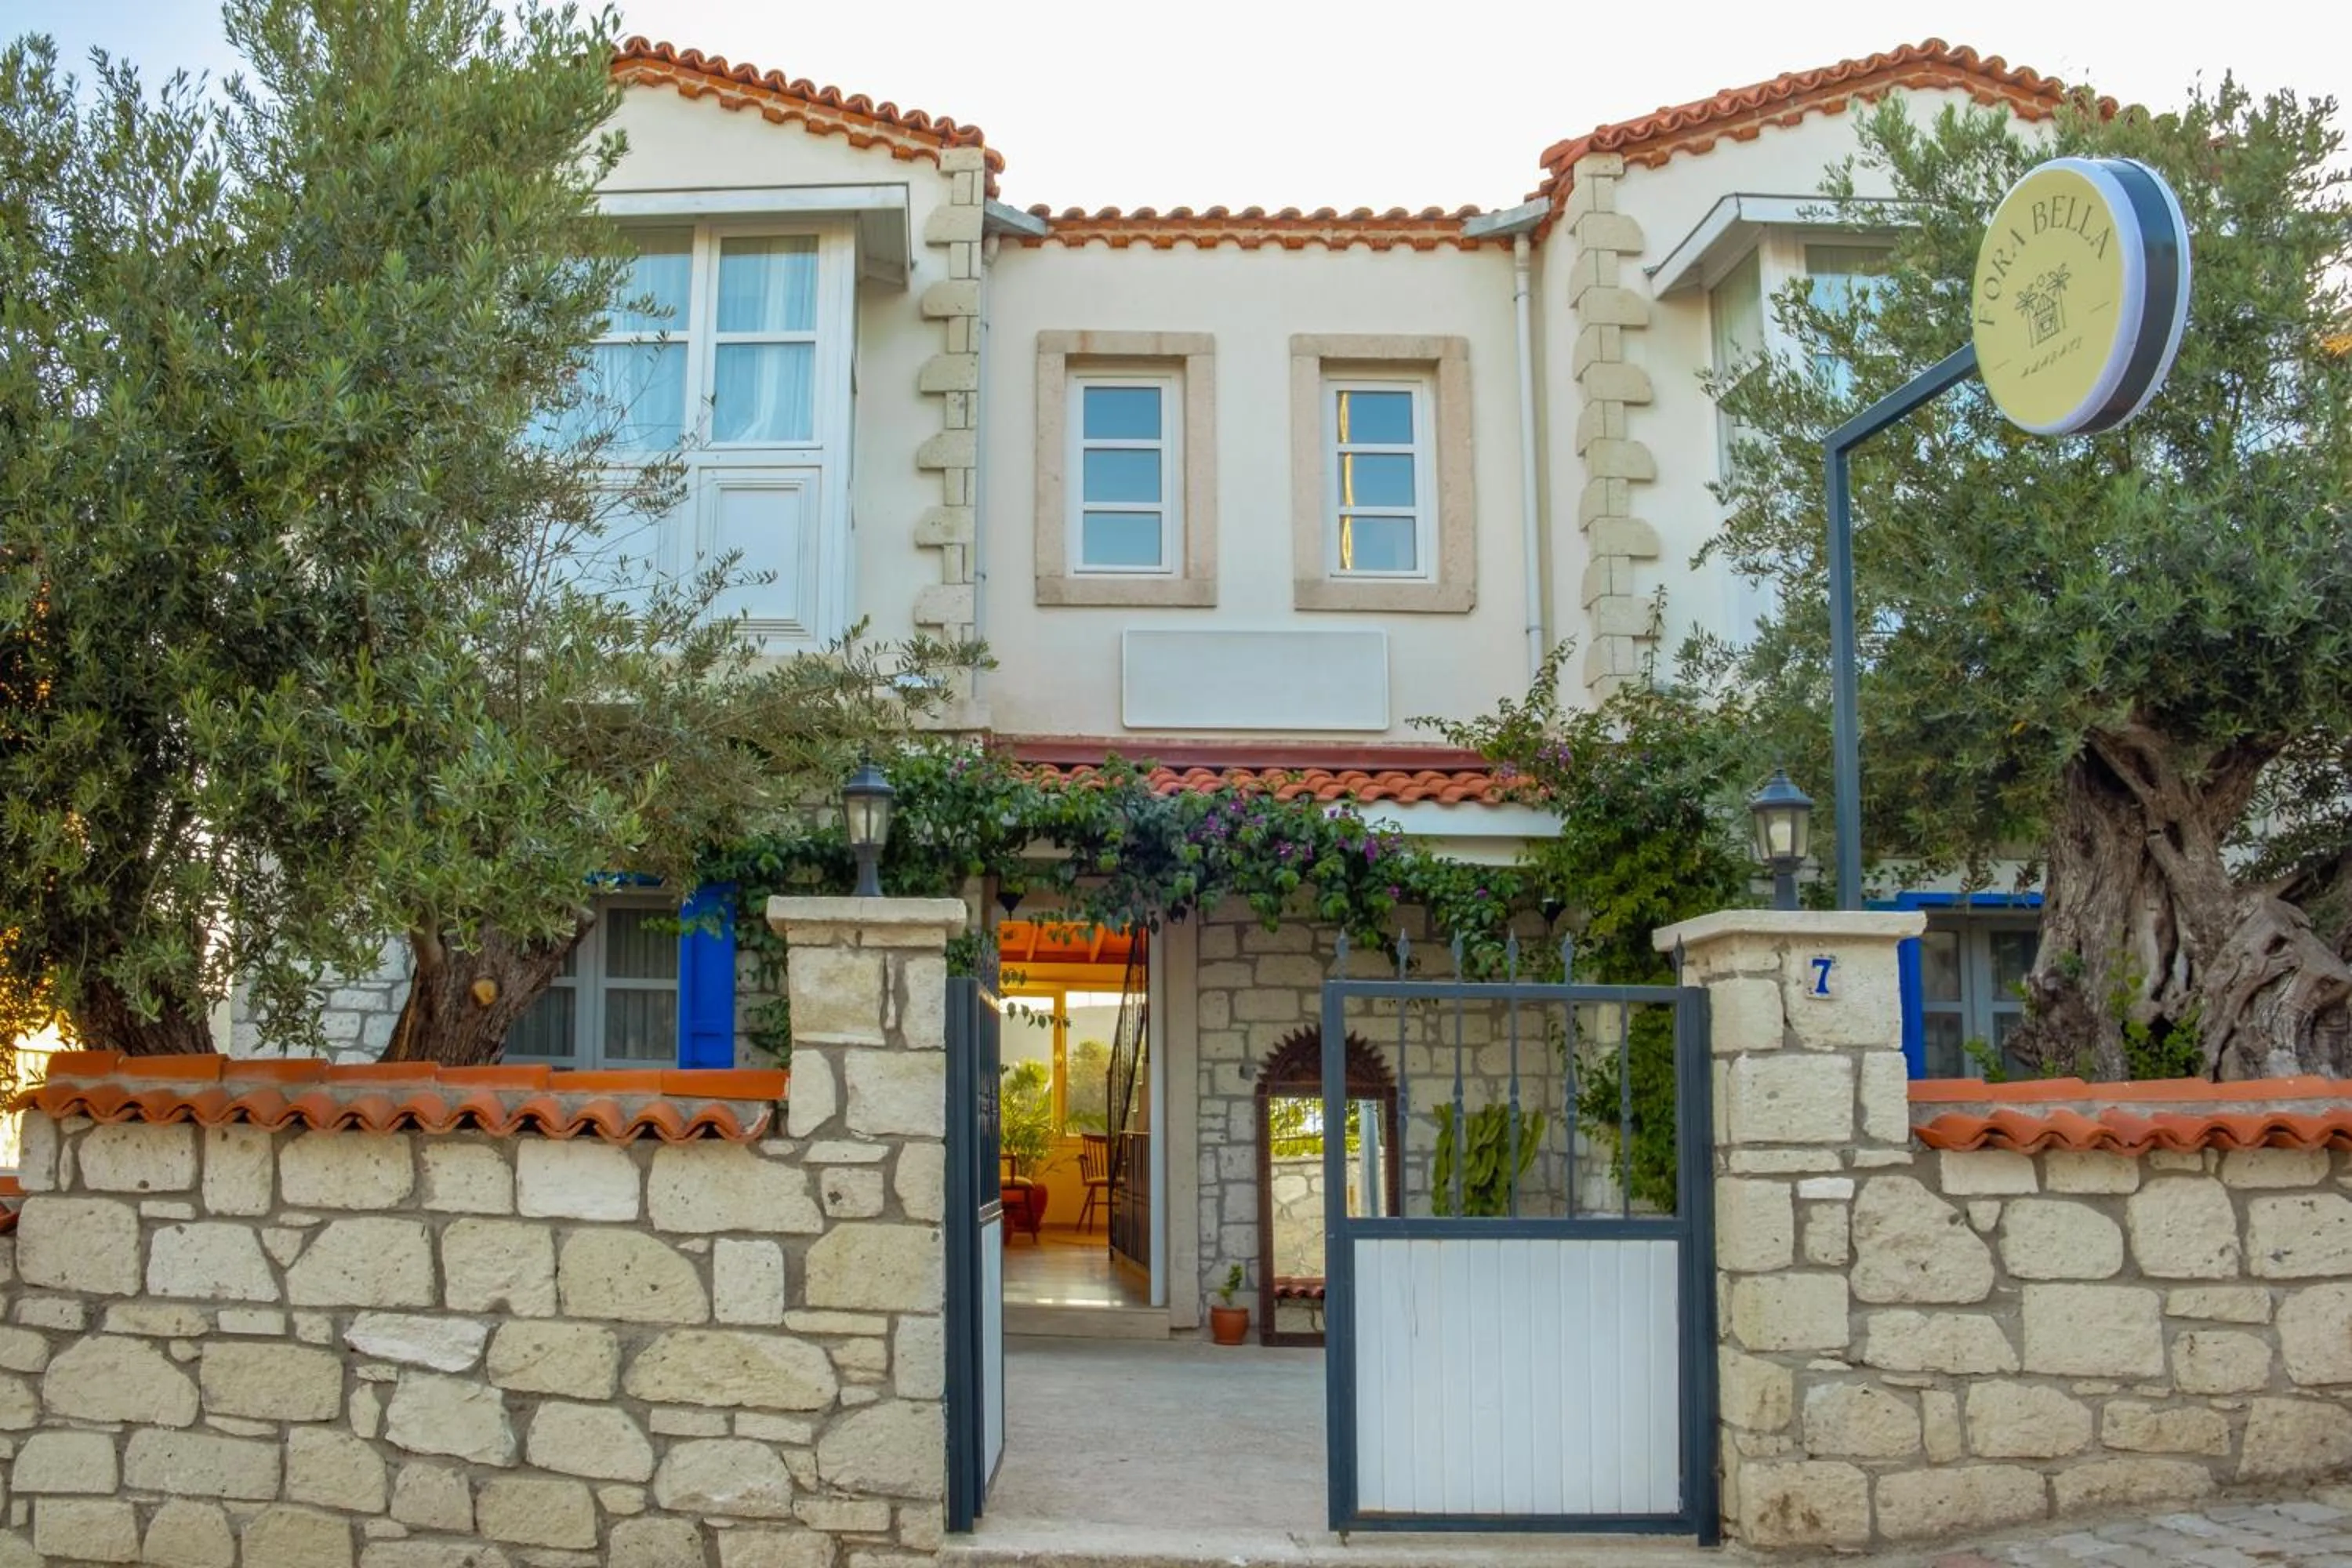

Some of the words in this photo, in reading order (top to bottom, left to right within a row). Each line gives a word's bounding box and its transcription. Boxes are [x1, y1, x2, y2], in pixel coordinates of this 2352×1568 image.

[1978, 227, 2026, 326] FORA
[2031, 195, 2111, 260] BELLA
[1811, 958, 1832, 994] 7
